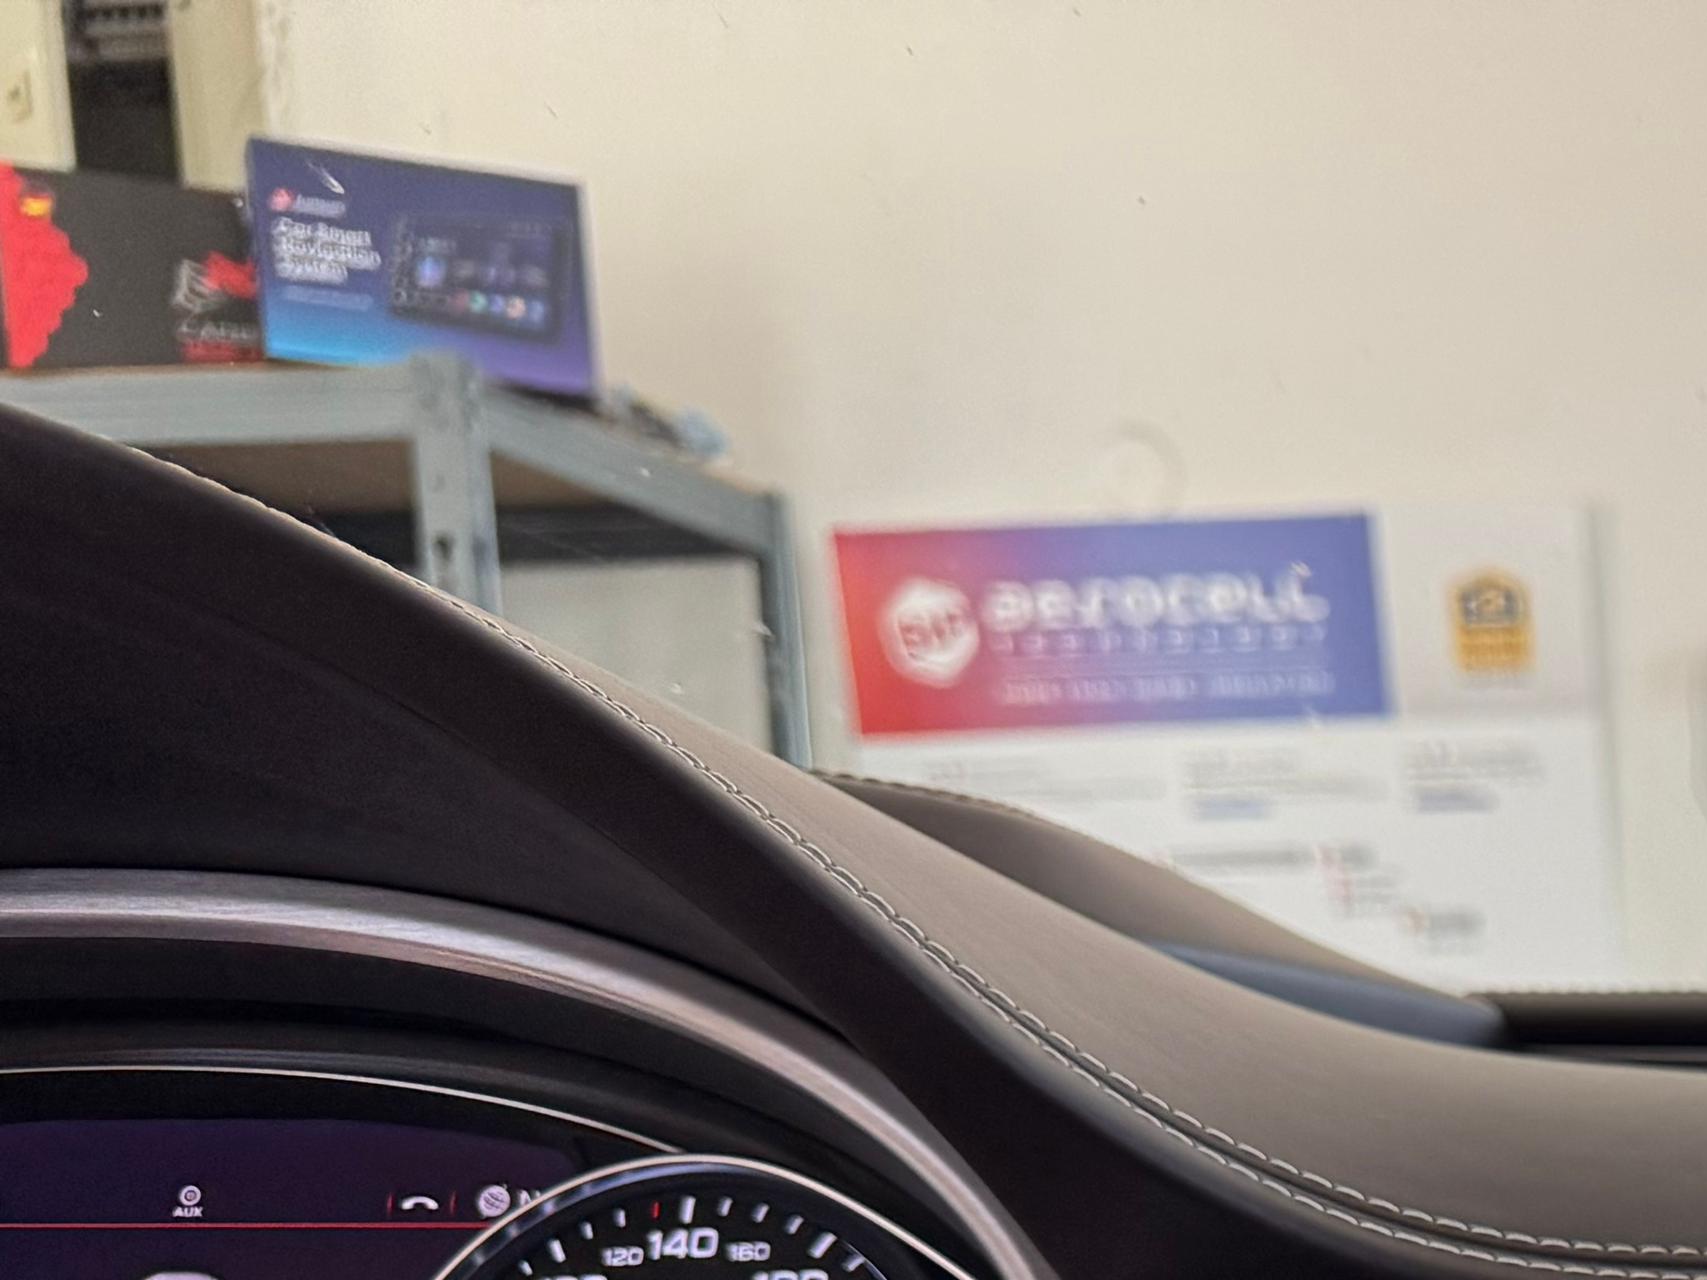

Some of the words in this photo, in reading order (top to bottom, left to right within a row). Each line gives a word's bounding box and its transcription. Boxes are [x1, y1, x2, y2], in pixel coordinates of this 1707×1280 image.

[172, 1205, 204, 1218] AUX
[647, 1228, 718, 1259] 140
[727, 1241, 770, 1262] 160
[602, 1245, 643, 1267] 120
